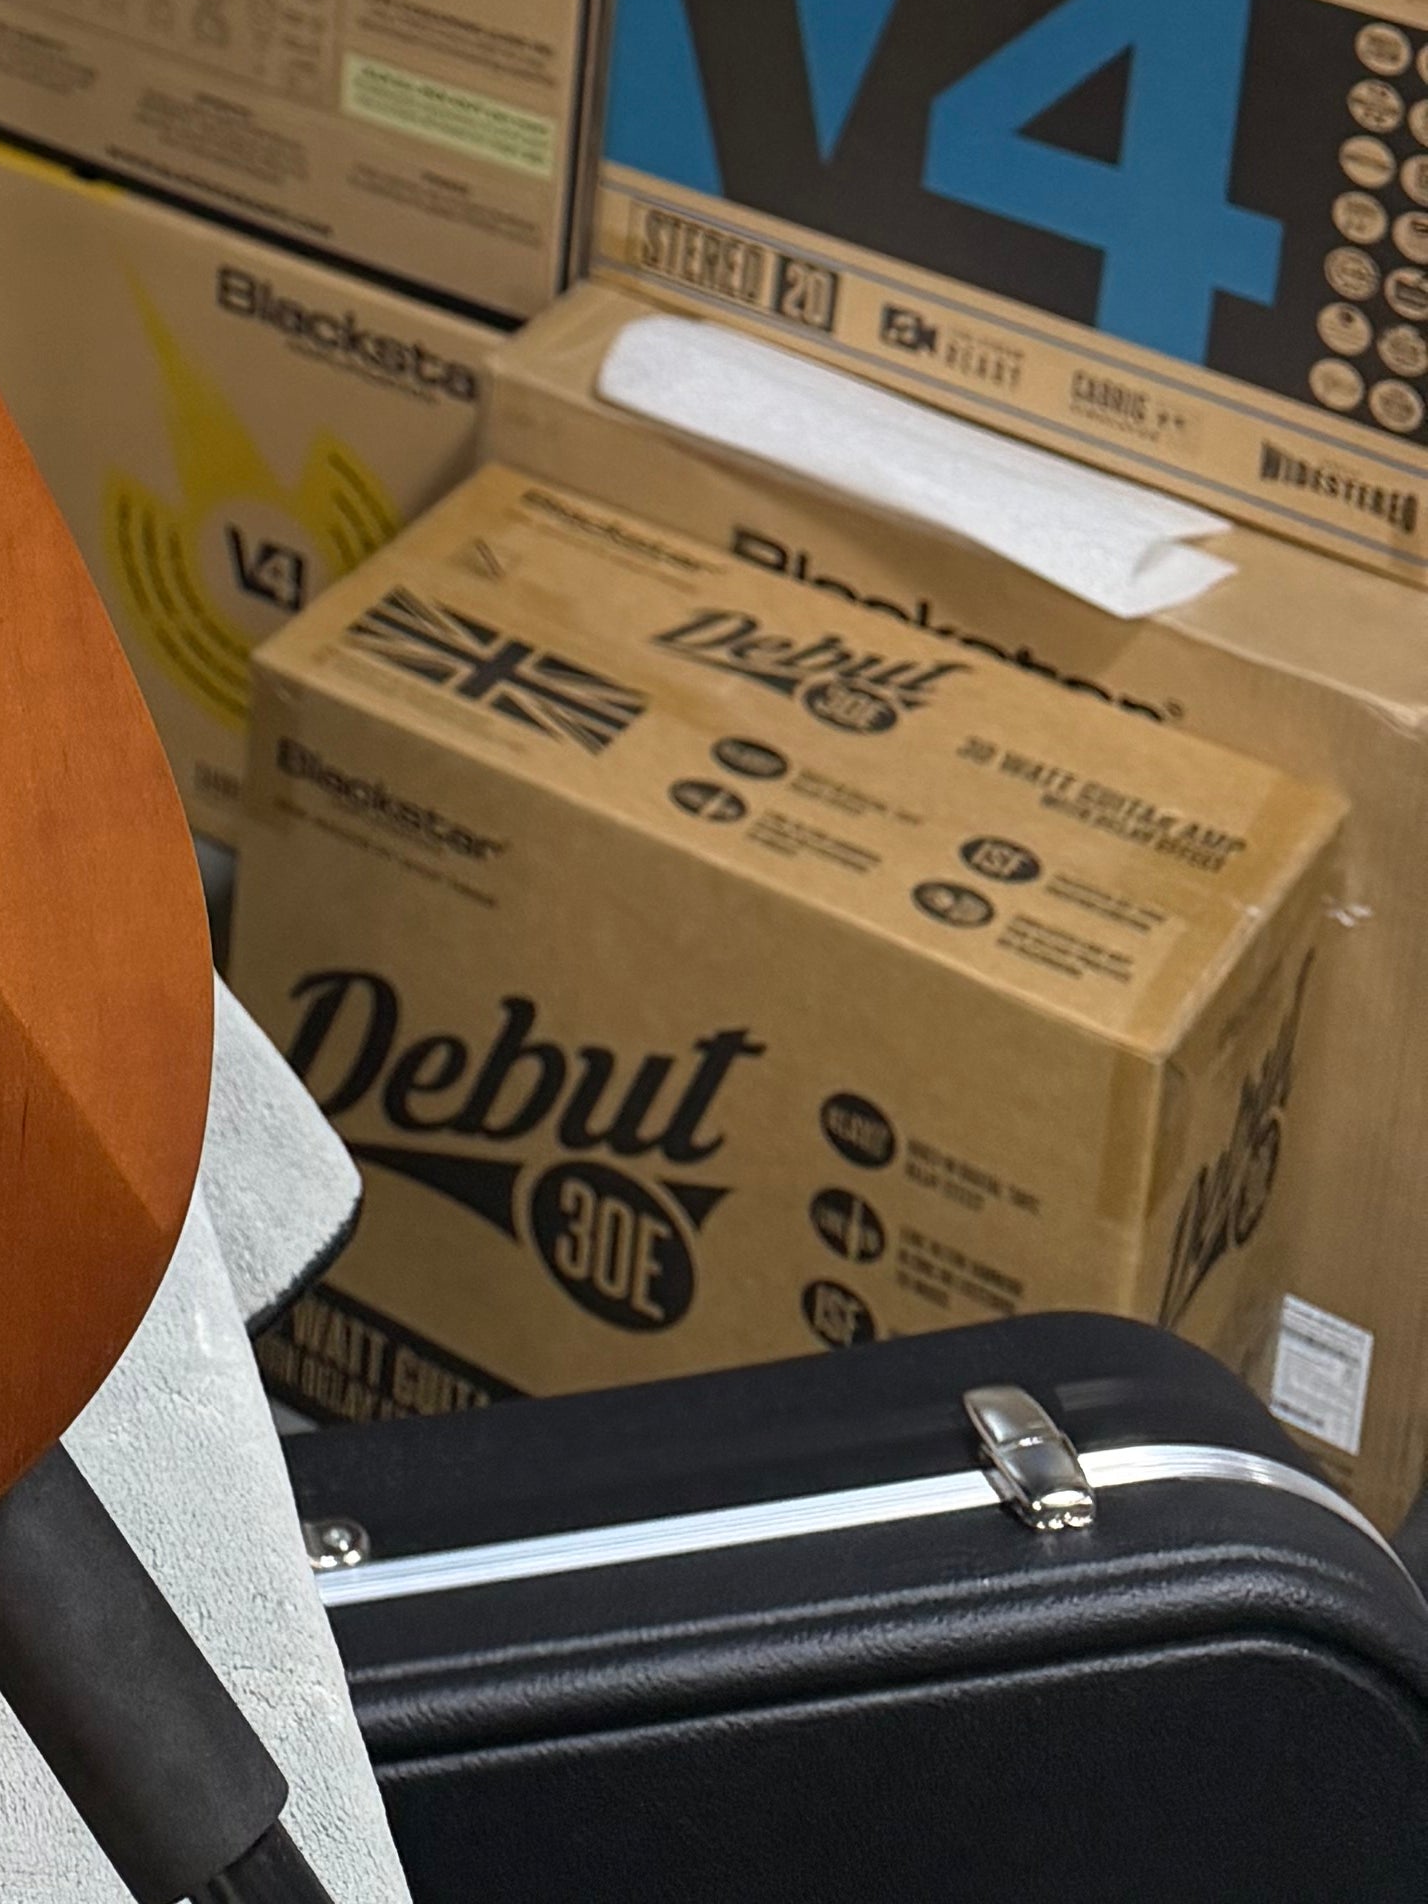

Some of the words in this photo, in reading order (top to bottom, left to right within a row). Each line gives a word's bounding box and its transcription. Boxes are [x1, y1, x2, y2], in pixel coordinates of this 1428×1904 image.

[216, 265, 479, 403] Blacksta
[641, 211, 767, 306] STEREO
[780, 258, 834, 330] 20
[652, 606, 973, 692] Debut
[275, 733, 507, 860] Blackstar
[289, 968, 768, 1165] Debut
[555, 1176, 670, 1322] 30E
